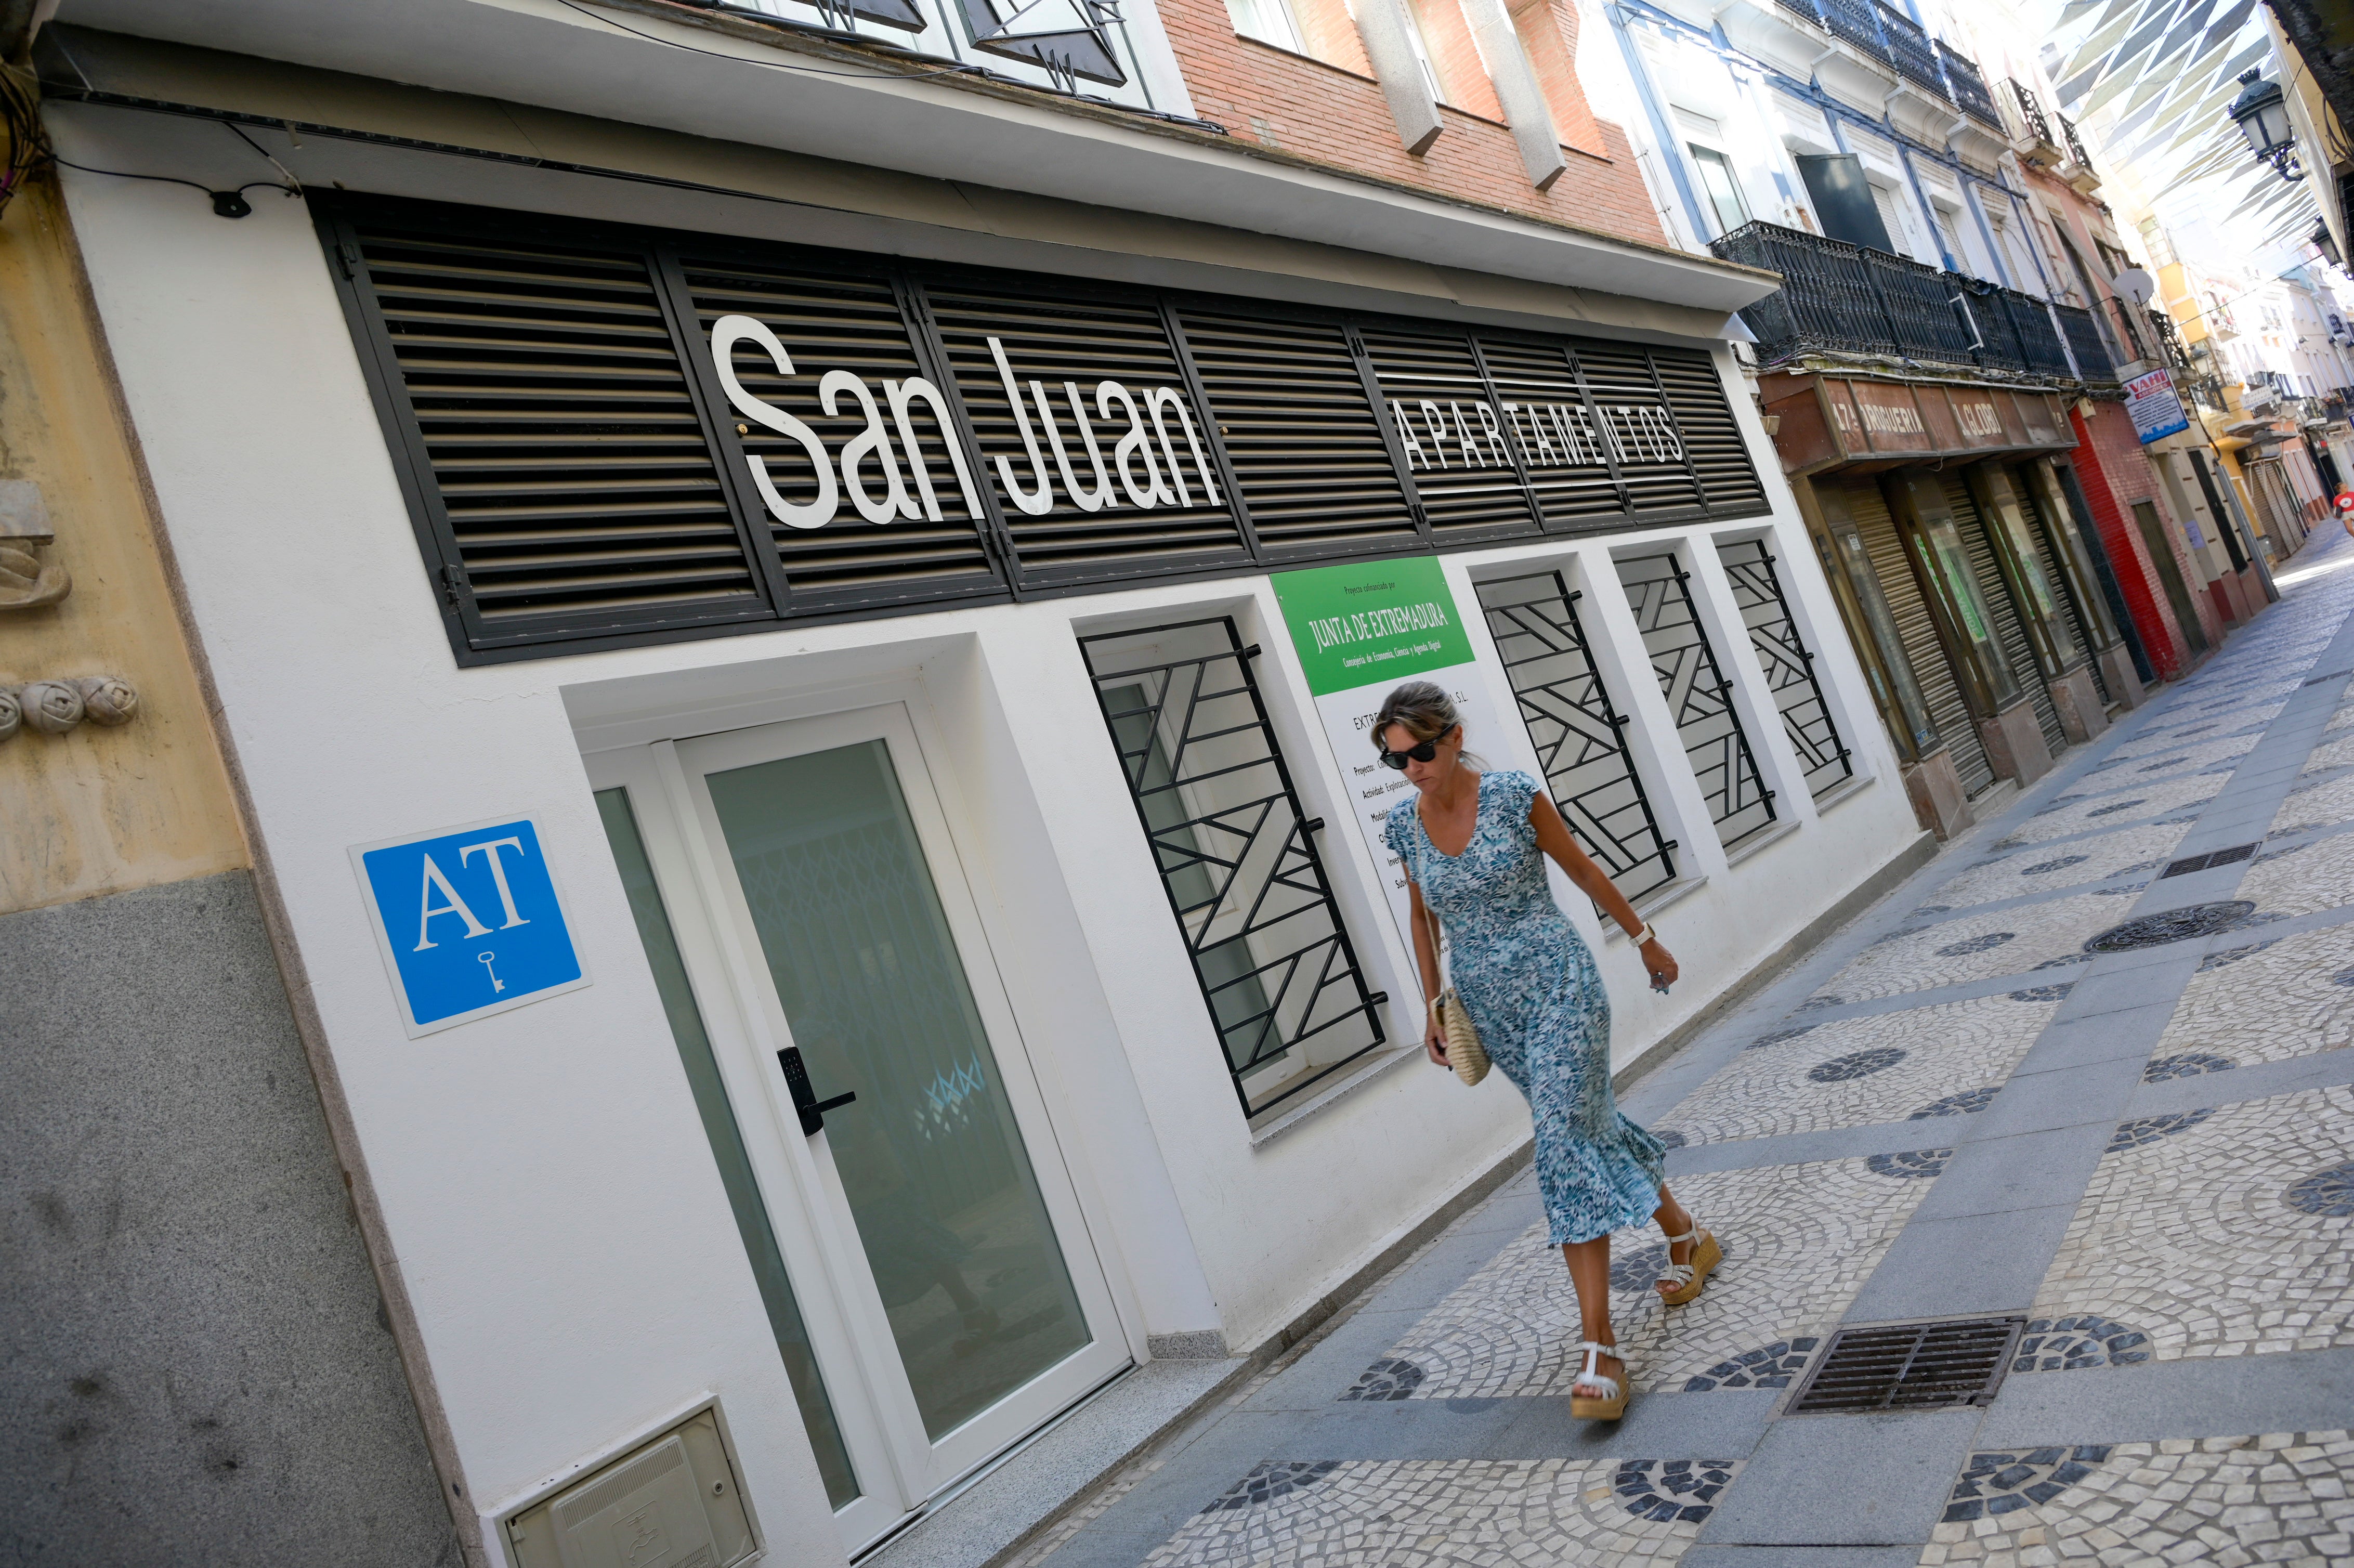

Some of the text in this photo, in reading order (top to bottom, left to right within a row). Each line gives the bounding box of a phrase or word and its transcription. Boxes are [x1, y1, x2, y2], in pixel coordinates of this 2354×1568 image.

[2139, 383, 2168, 398] ASESORES
[711, 315, 1221, 529] San Juan
[1392, 399, 1684, 471] APARTAMENTOS
[1963, 403, 2002, 436] GLOBO
[1344, 586, 1363, 596] Proyecto
[1364, 582, 1388, 592] cofinanciado
[1309, 602, 1449, 654] JUNTA DE EXTREMADURA
[1343, 652, 1366, 668] Consejería
[1366, 651, 1373, 662] de
[1394, 646, 1409, 657] Ciencia
[1409, 647, 1414, 657] y
[1414, 643, 1429, 656] Agenda
[1428, 639, 1442, 652] Digital
[1354, 764, 1375, 776] Proyecto:
[1363, 777, 1411, 799] Actividad: Explotación
[413, 835, 531, 952] AT
